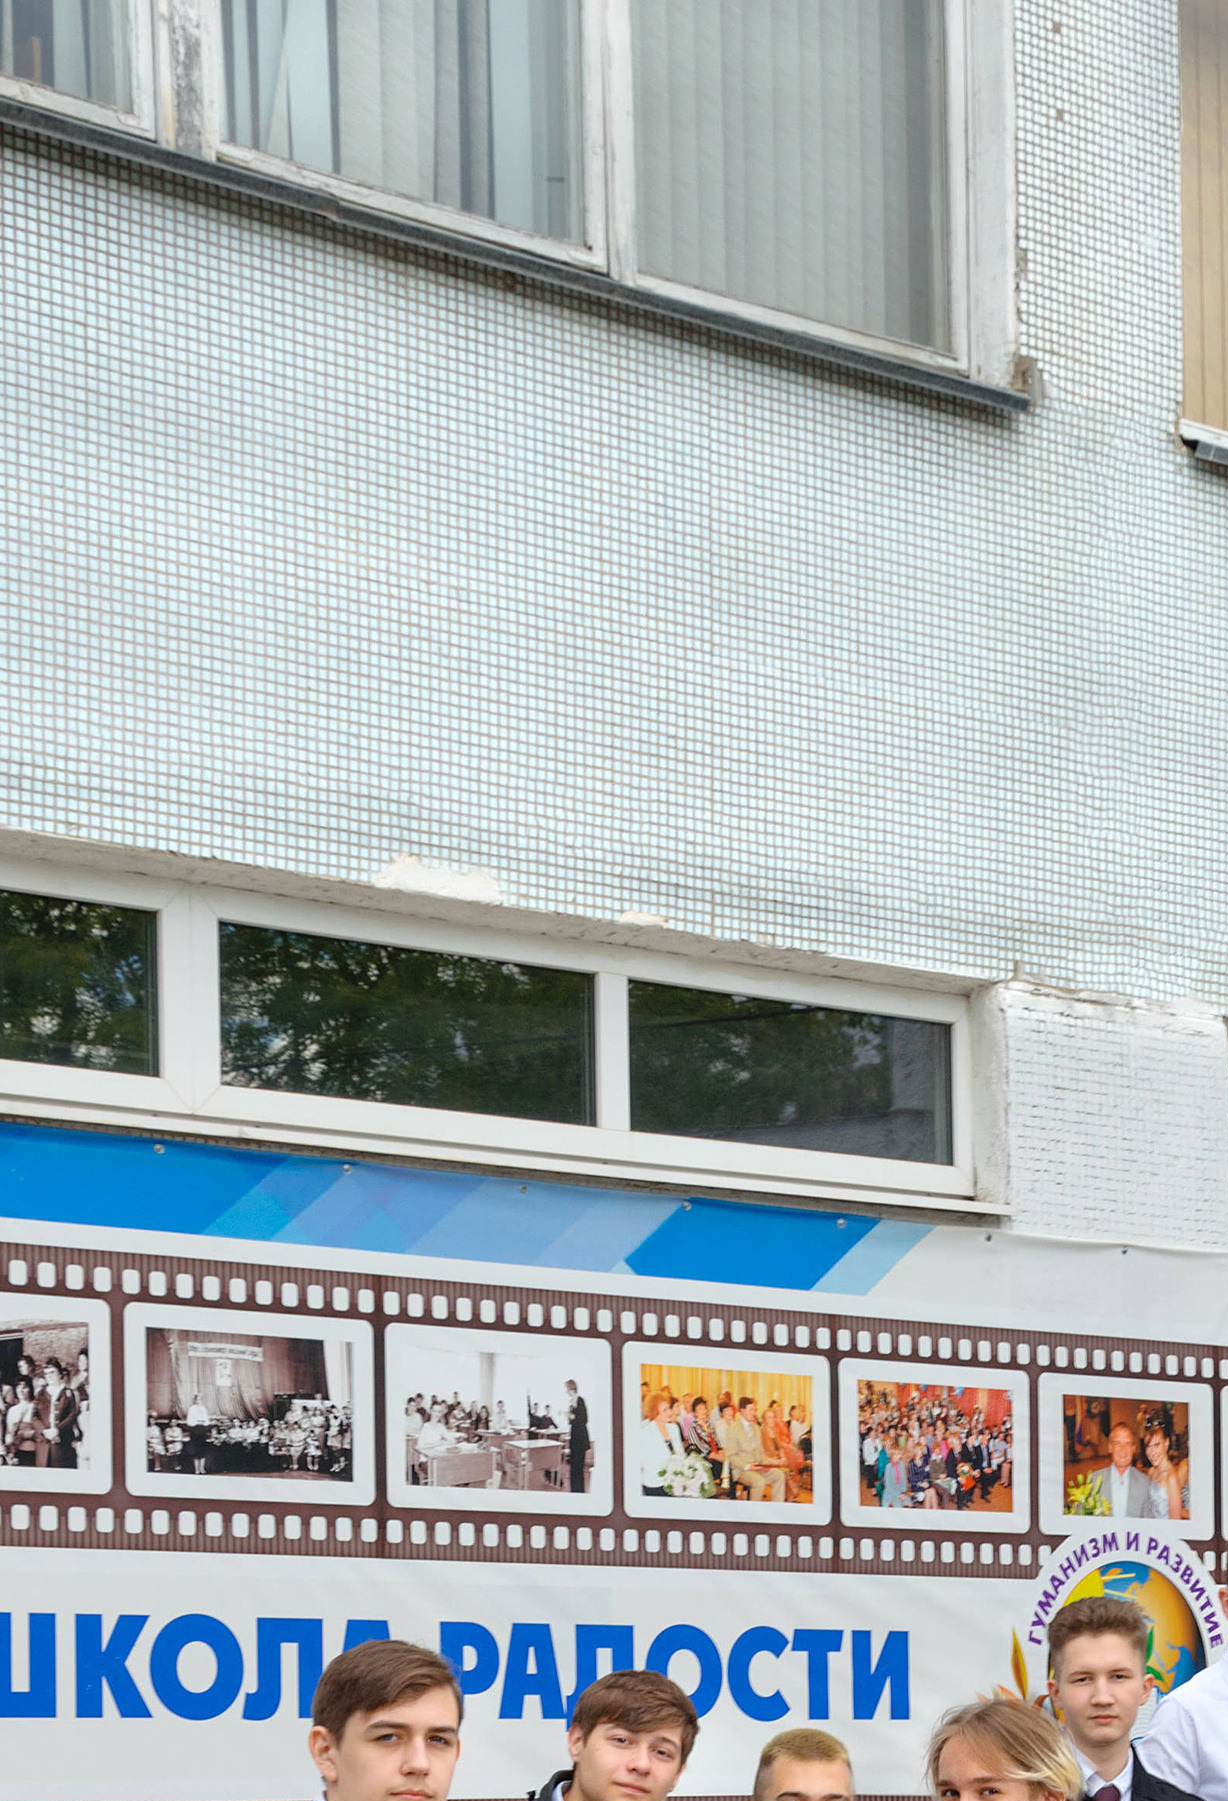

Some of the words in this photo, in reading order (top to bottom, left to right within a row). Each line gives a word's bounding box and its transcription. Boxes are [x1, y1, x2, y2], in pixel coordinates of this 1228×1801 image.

[1027, 1532, 1119, 1645] ГУМАНИЗМ
[1125, 1531, 1140, 1551] И
[1146, 1536, 1224, 1649] РАЗВИТИЕ
[0, 1612, 391, 1721] КОЛ
